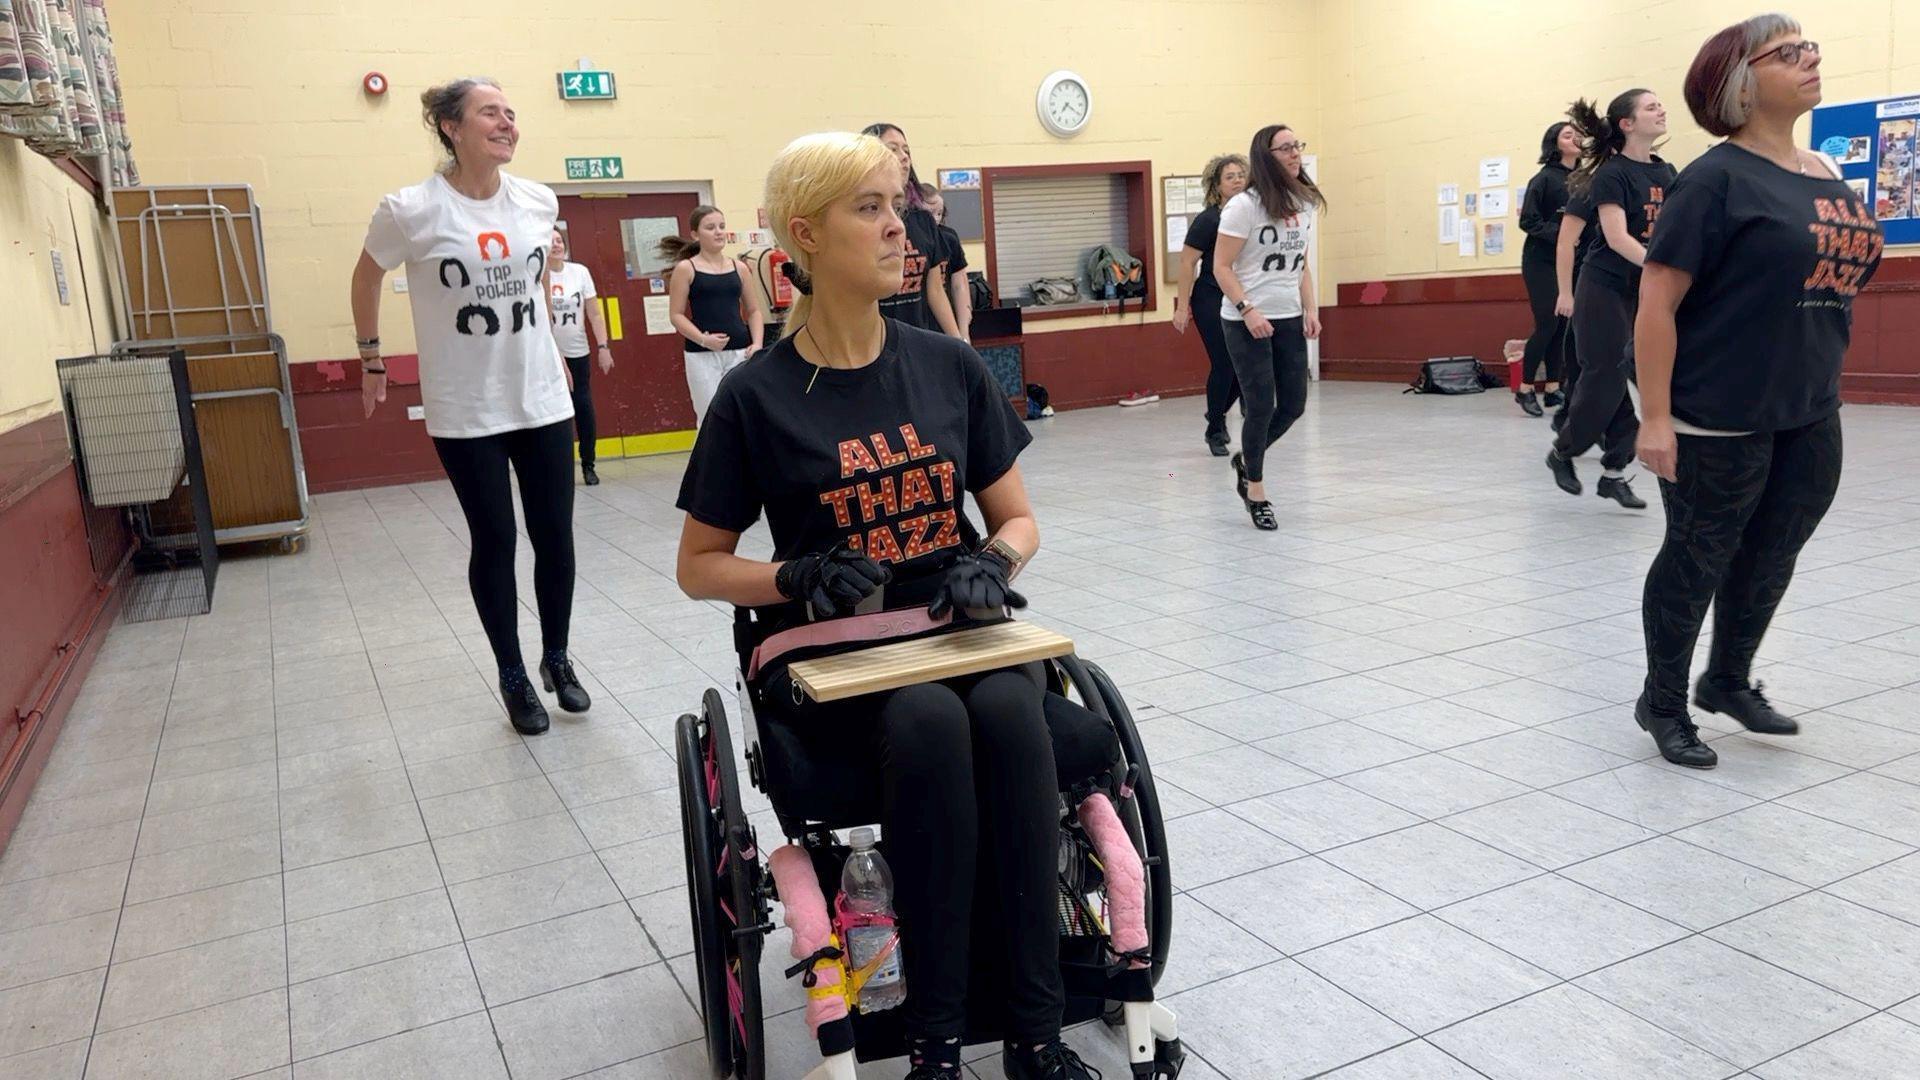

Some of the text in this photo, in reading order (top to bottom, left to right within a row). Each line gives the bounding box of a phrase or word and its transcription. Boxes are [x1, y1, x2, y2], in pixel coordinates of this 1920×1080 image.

[568, 160, 587, 169] FIRE
[569, 169, 587, 177] EXIT
[1813, 197, 1877, 230] ALL
[1808, 222, 1884, 264] THAT
[484, 265, 512, 283] TAP
[475, 280, 527, 300] POWER!
[838, 423, 937, 479] ALL
[819, 461, 956, 528] THAT
